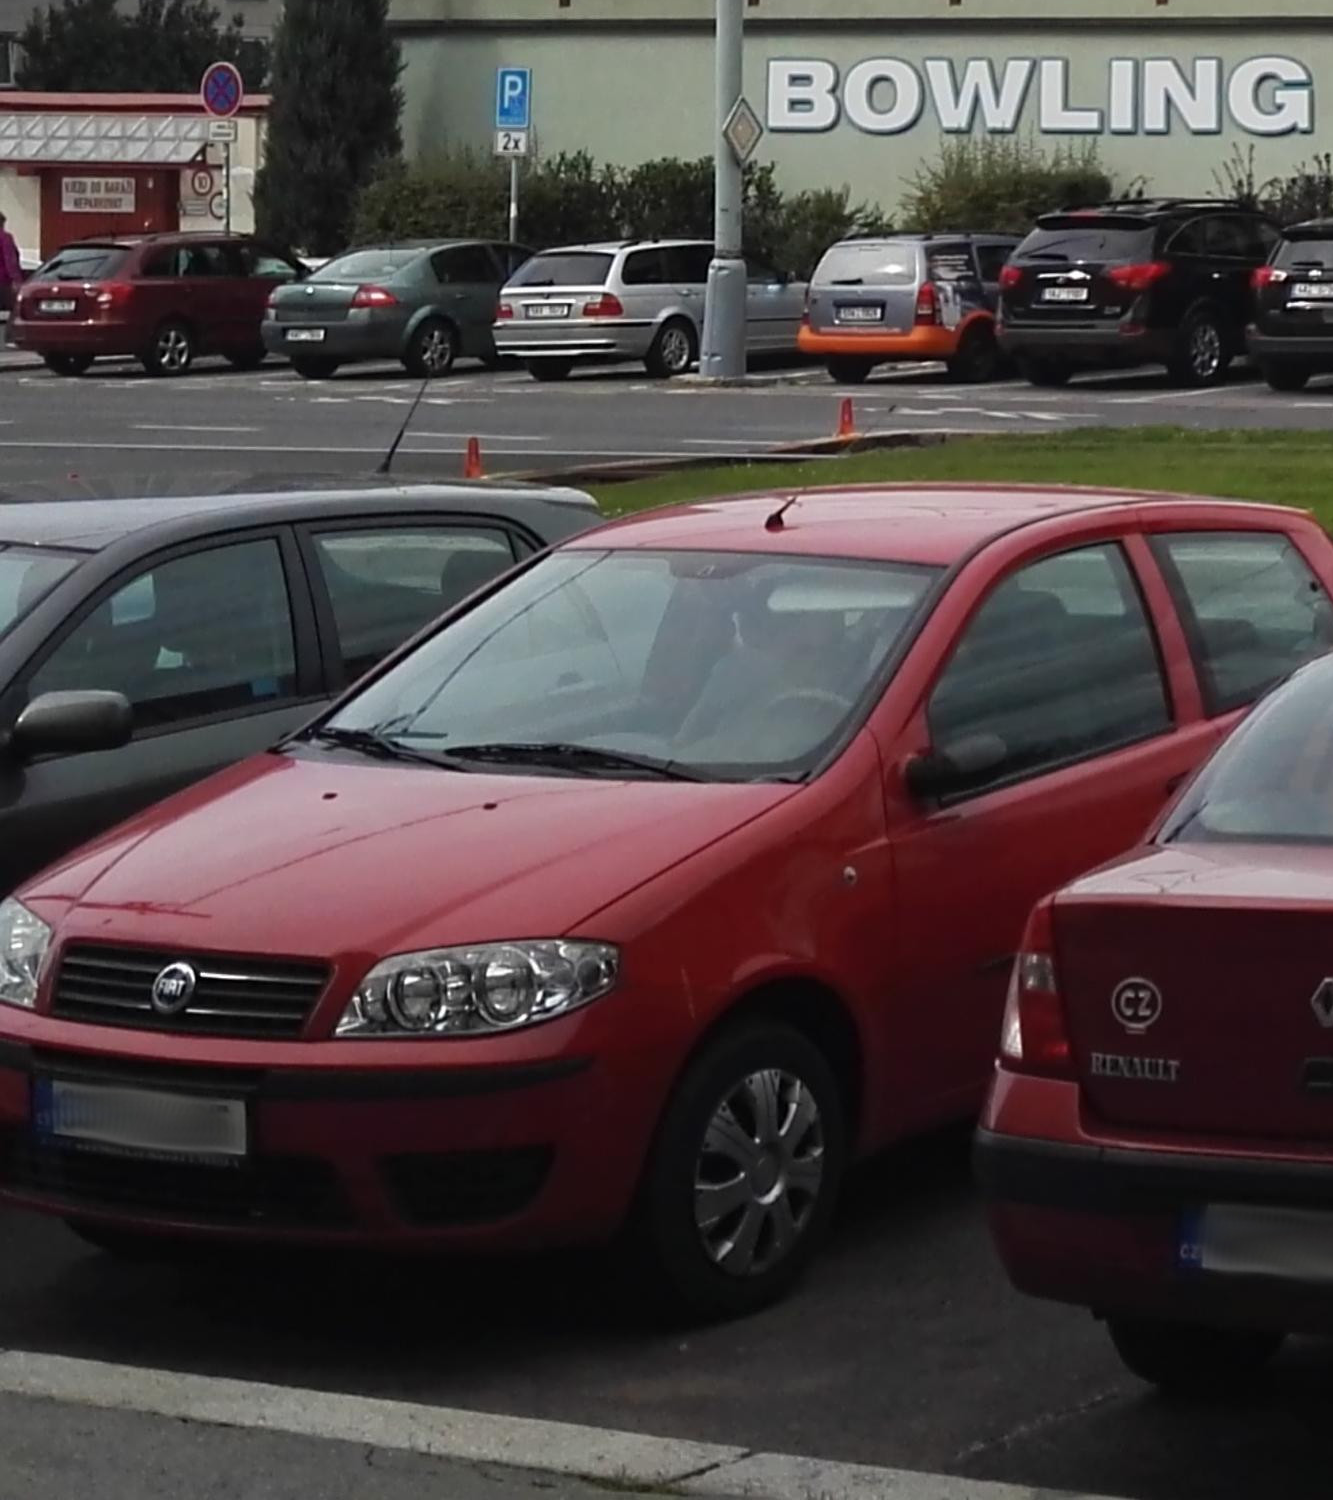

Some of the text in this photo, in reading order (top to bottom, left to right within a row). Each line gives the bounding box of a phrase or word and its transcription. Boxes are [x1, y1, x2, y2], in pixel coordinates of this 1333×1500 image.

[503, 74, 523, 109] P
[766, 55, 1316, 136] BOWLING
[502, 132, 521, 151] 2x
[156, 977, 186, 997] FIAT
[1119, 989, 1152, 1016] CZ
[1090, 1052, 1181, 1081] RENAULT
